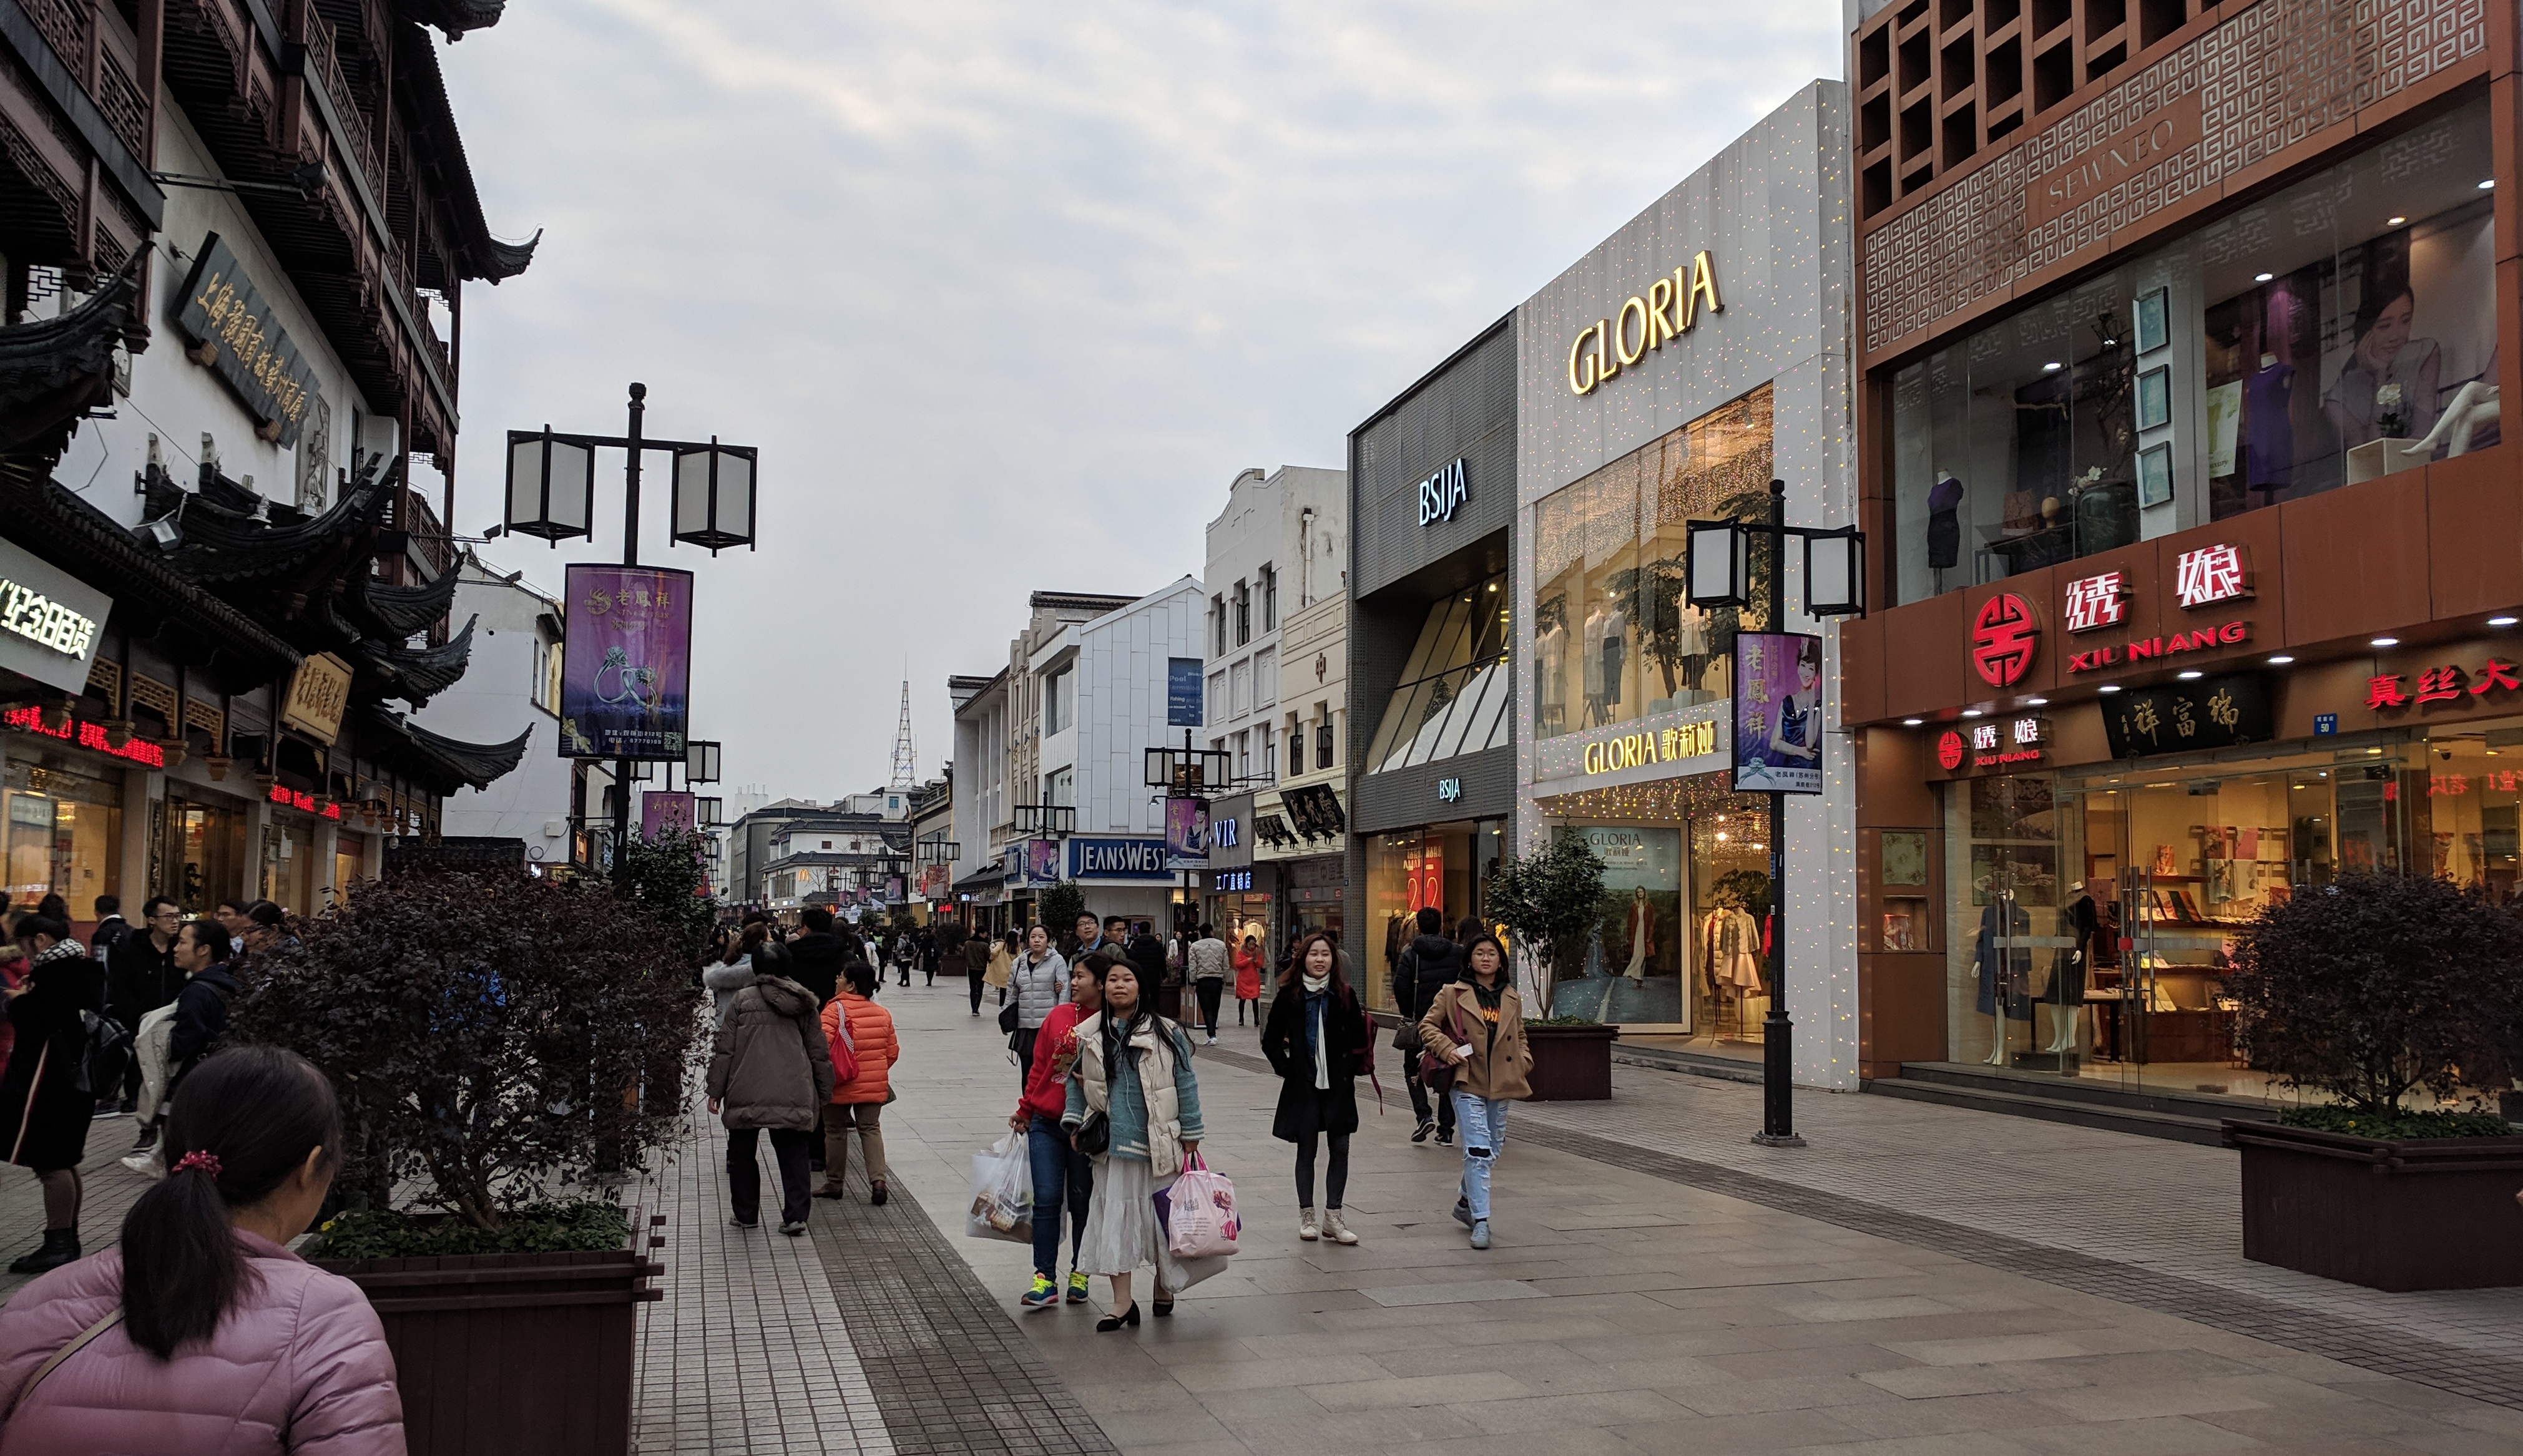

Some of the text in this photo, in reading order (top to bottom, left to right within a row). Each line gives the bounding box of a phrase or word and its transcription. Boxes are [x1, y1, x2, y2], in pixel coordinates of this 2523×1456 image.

[2049, 119, 2173, 208] SEWNEO
[1569, 250, 1723, 394] GLORIA
[1419, 457, 1469, 526] BSIJA
[2067, 621, 2245, 673] XIU NIANG
[2363, 659, 2520, 710] 真丝大
[1585, 720, 1714, 775] GLORIA 歌莉娅
[2320, 723, 2329, 733] 50
[1974, 750, 2040, 766] XIU NIANG
[1439, 778, 1461, 802] BSIJA
[1209, 819, 1237, 848] VIR
[1590, 833, 1642, 846] GLORIA
